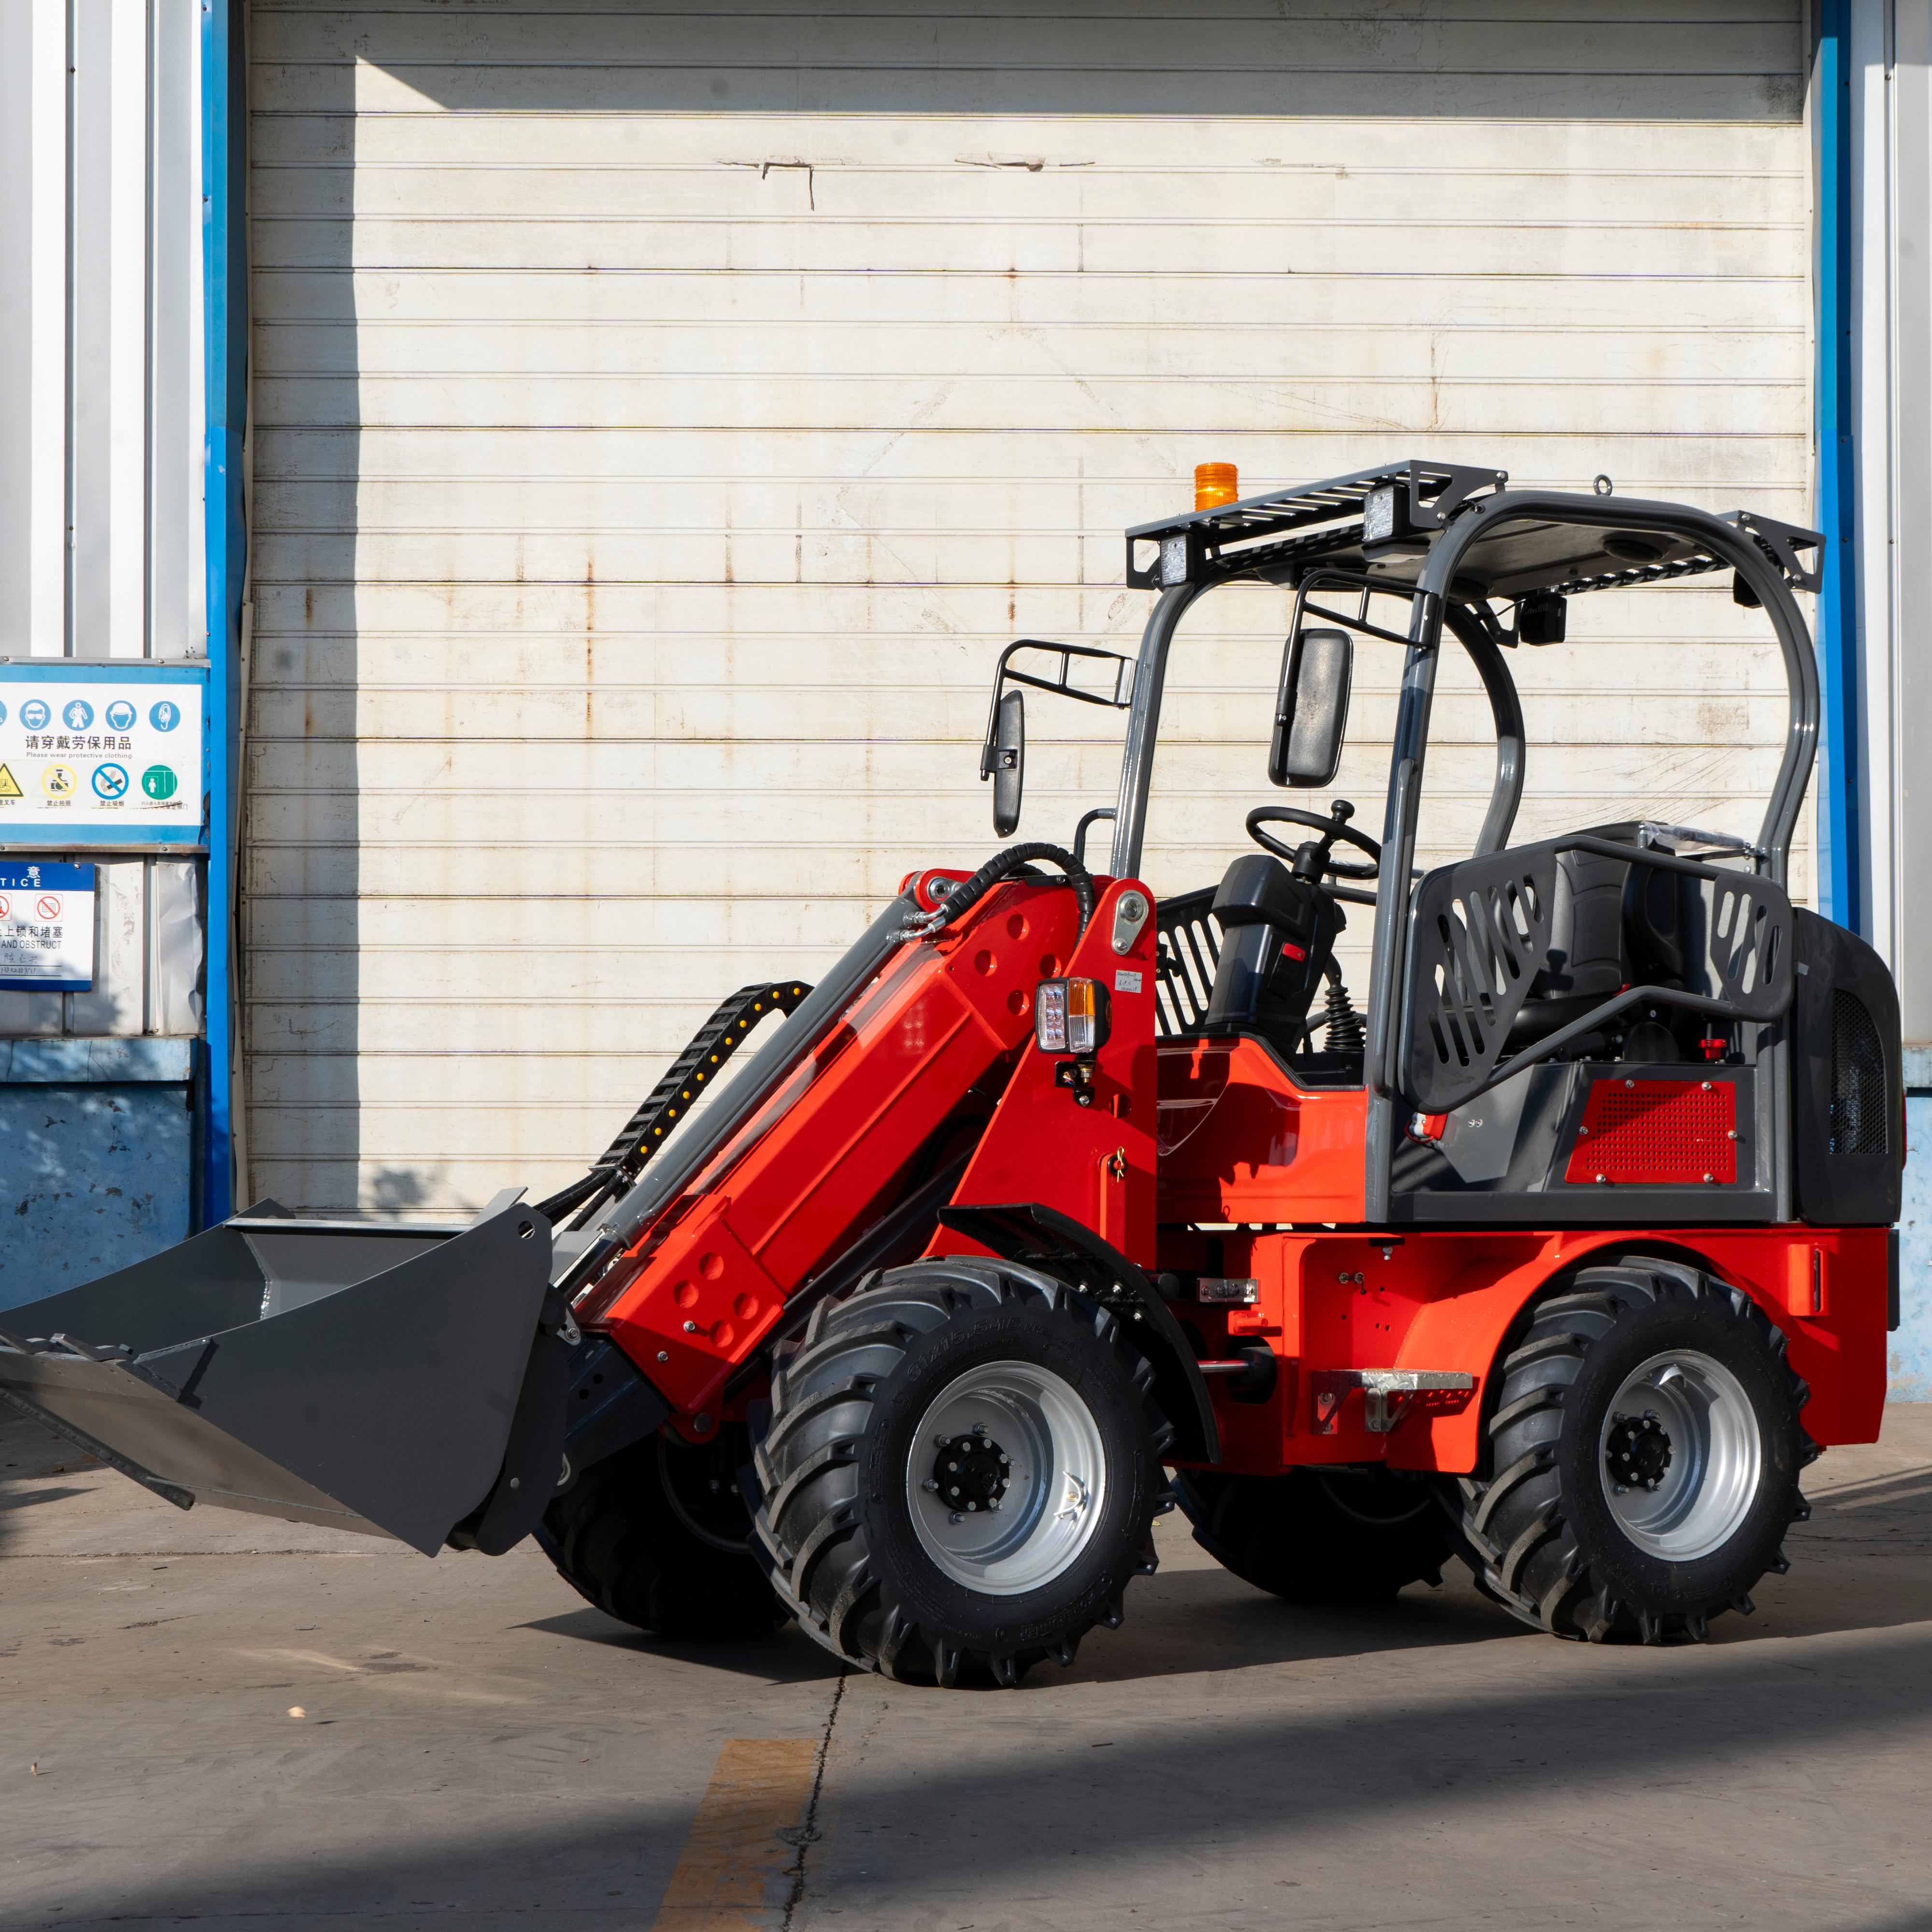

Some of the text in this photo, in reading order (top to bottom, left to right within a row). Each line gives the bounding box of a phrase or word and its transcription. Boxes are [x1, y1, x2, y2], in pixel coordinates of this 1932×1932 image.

[25, 735, 132, 750] 请穿戴劳保用品
[27, 866, 41, 879] 意
[0, 925, 62, 938] 上锁和堵塞
[2, 940, 61, 949] AND OBSTRUCT
